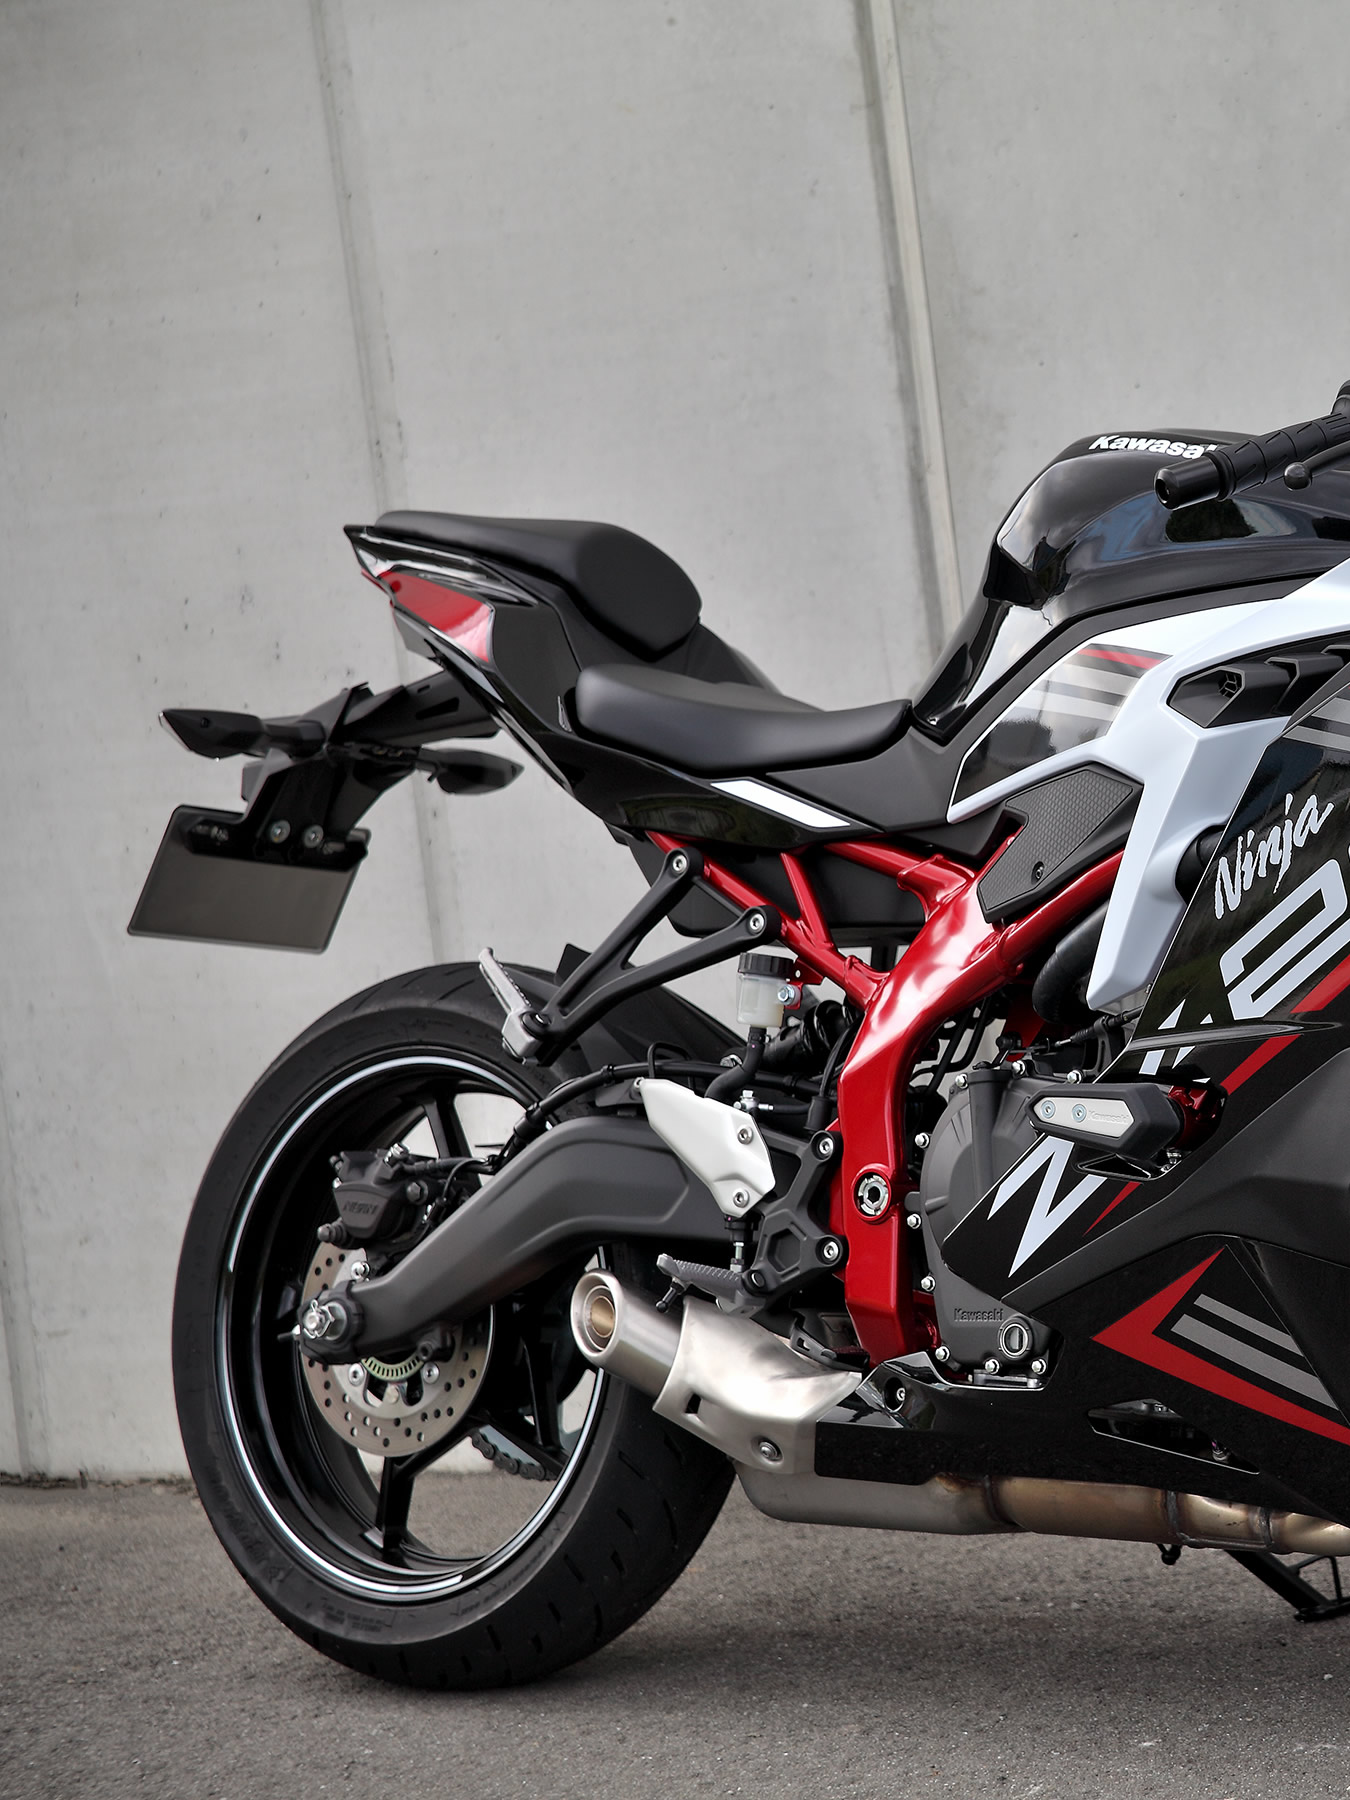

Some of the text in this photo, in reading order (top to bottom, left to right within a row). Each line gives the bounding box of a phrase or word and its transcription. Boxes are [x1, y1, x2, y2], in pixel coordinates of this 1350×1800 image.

[1088, 435, 1218, 460] Kawasa
[1213, 793, 1335, 920] Ninja
[1088, 1109, 1130, 1125] Kawasaki
[953, 1307, 1004, 1322] Kawasaki
